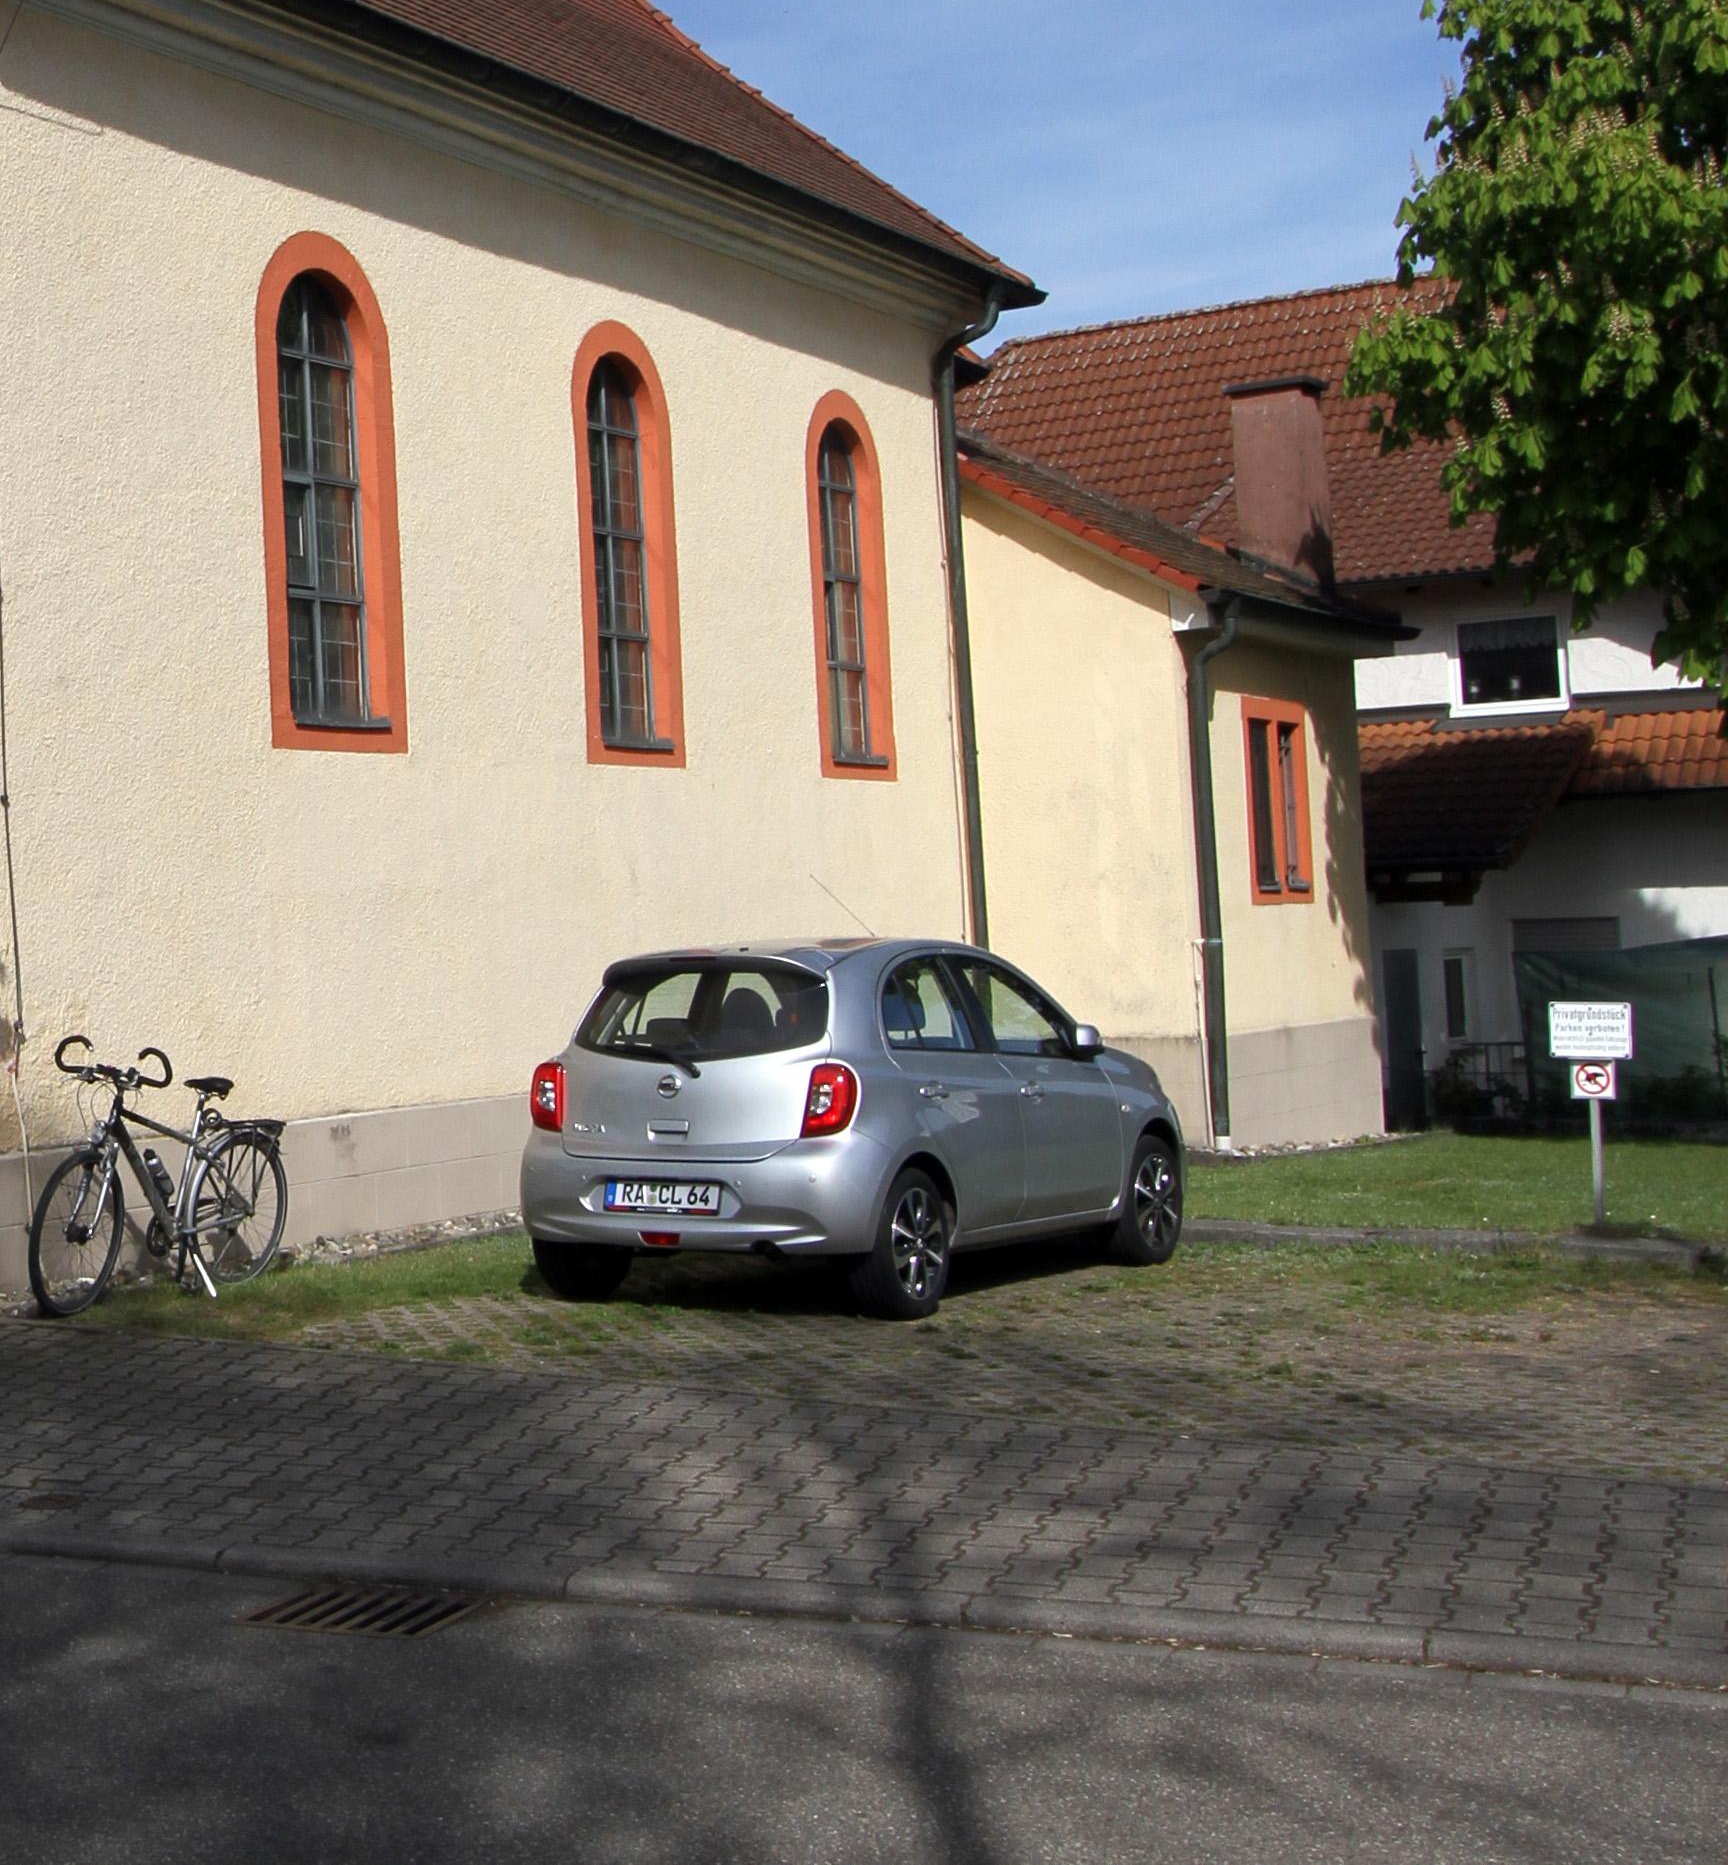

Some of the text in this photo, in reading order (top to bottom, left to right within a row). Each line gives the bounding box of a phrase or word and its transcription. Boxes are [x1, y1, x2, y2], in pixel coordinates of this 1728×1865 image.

[1555, 1023, 1583, 1032] Parken
[622, 1183, 644, 1203] RA
[659, 1185, 682, 1205] CL
[687, 1185, 710, 1206] 64
